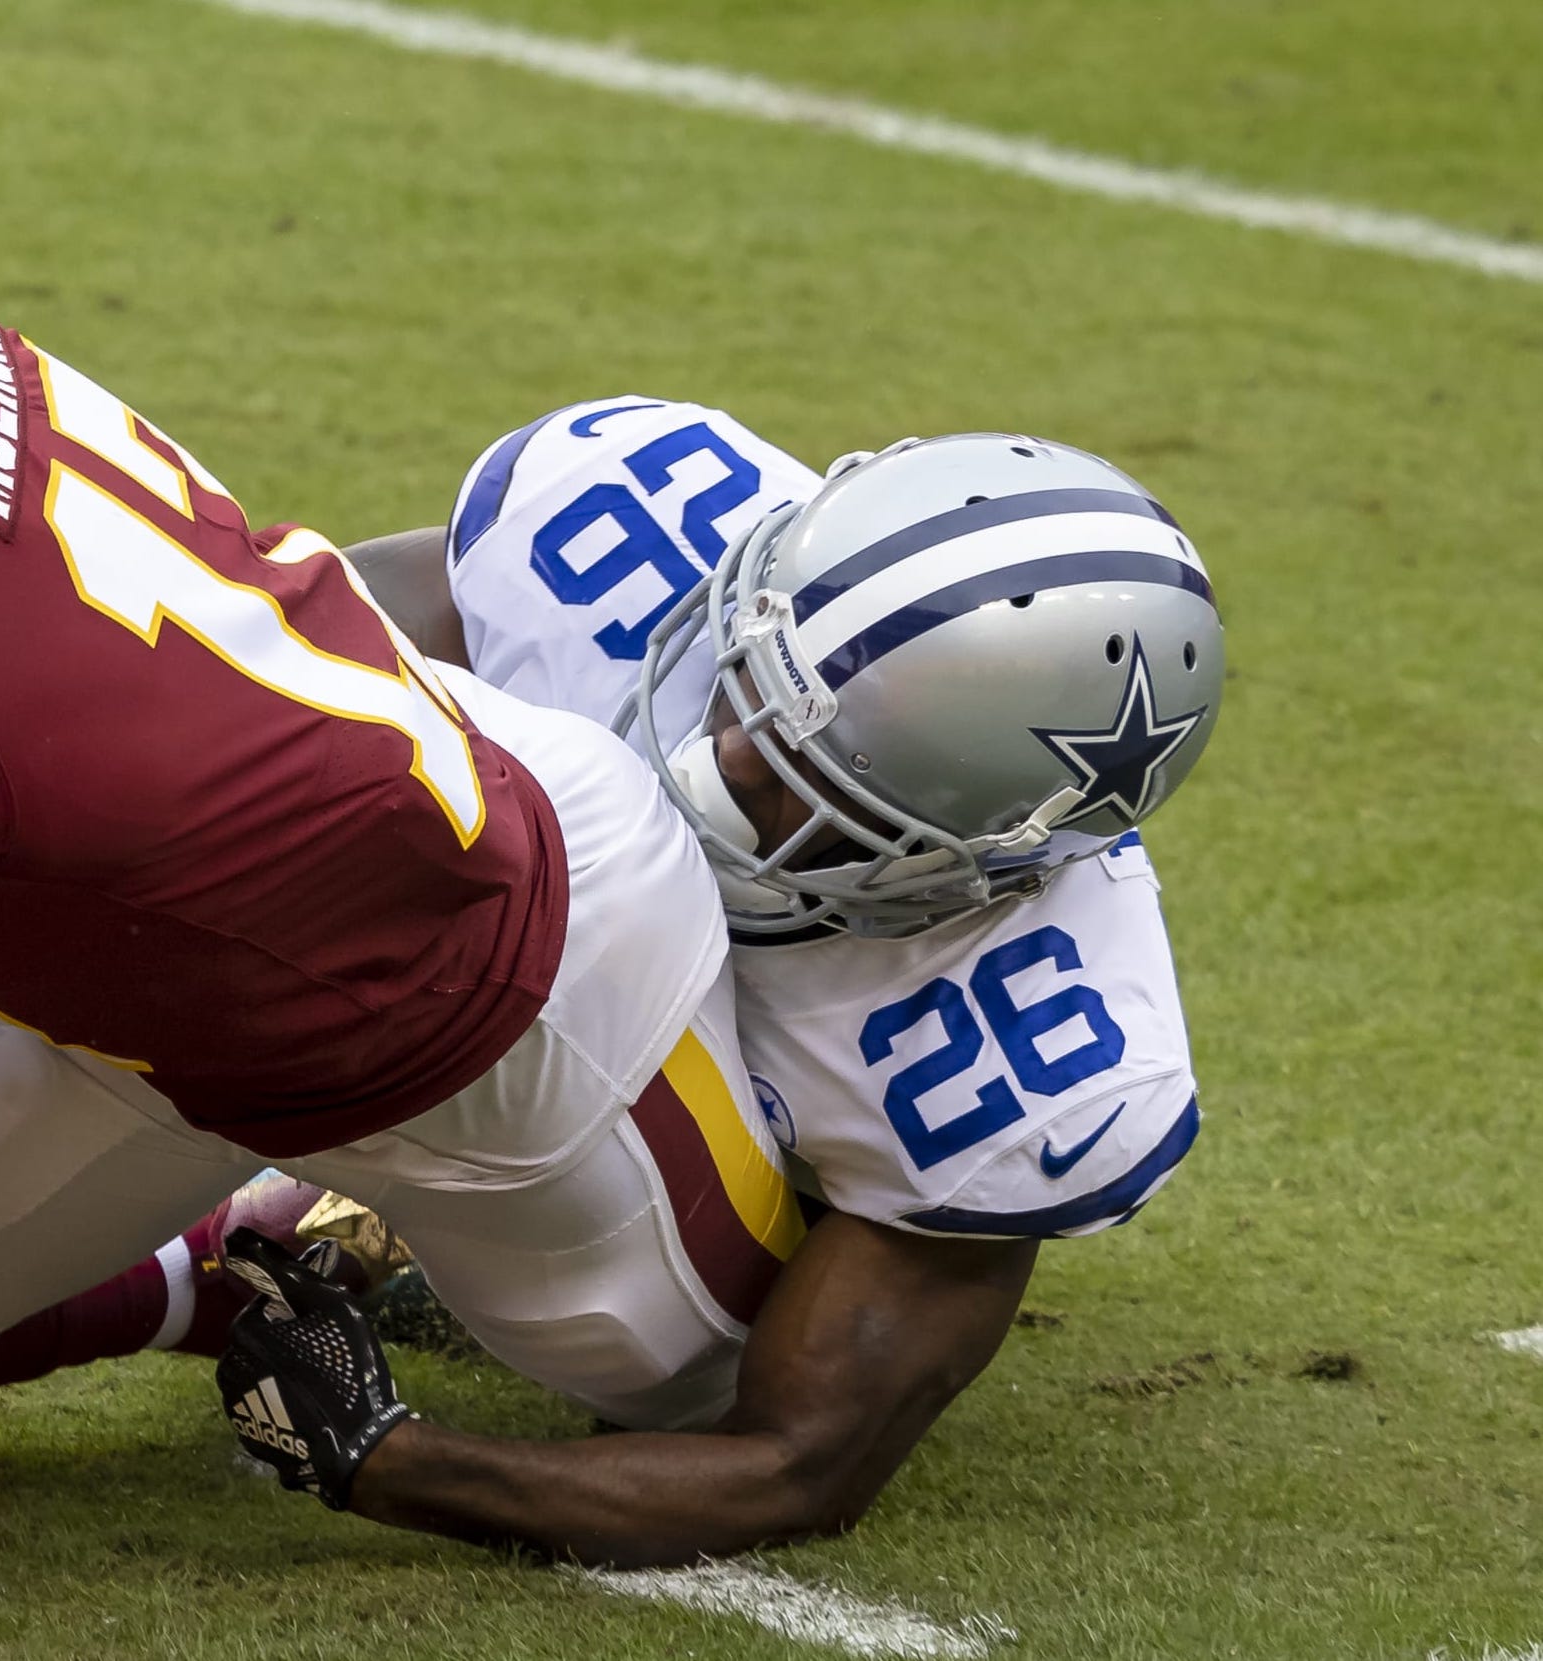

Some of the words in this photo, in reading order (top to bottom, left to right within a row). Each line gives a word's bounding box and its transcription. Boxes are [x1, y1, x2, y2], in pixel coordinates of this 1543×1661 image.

[530, 421, 762, 660] 26
[775, 629, 809, 695] COWBOYS
[858, 924, 1126, 1172] 26
[232, 1416, 310, 1461] adidas
